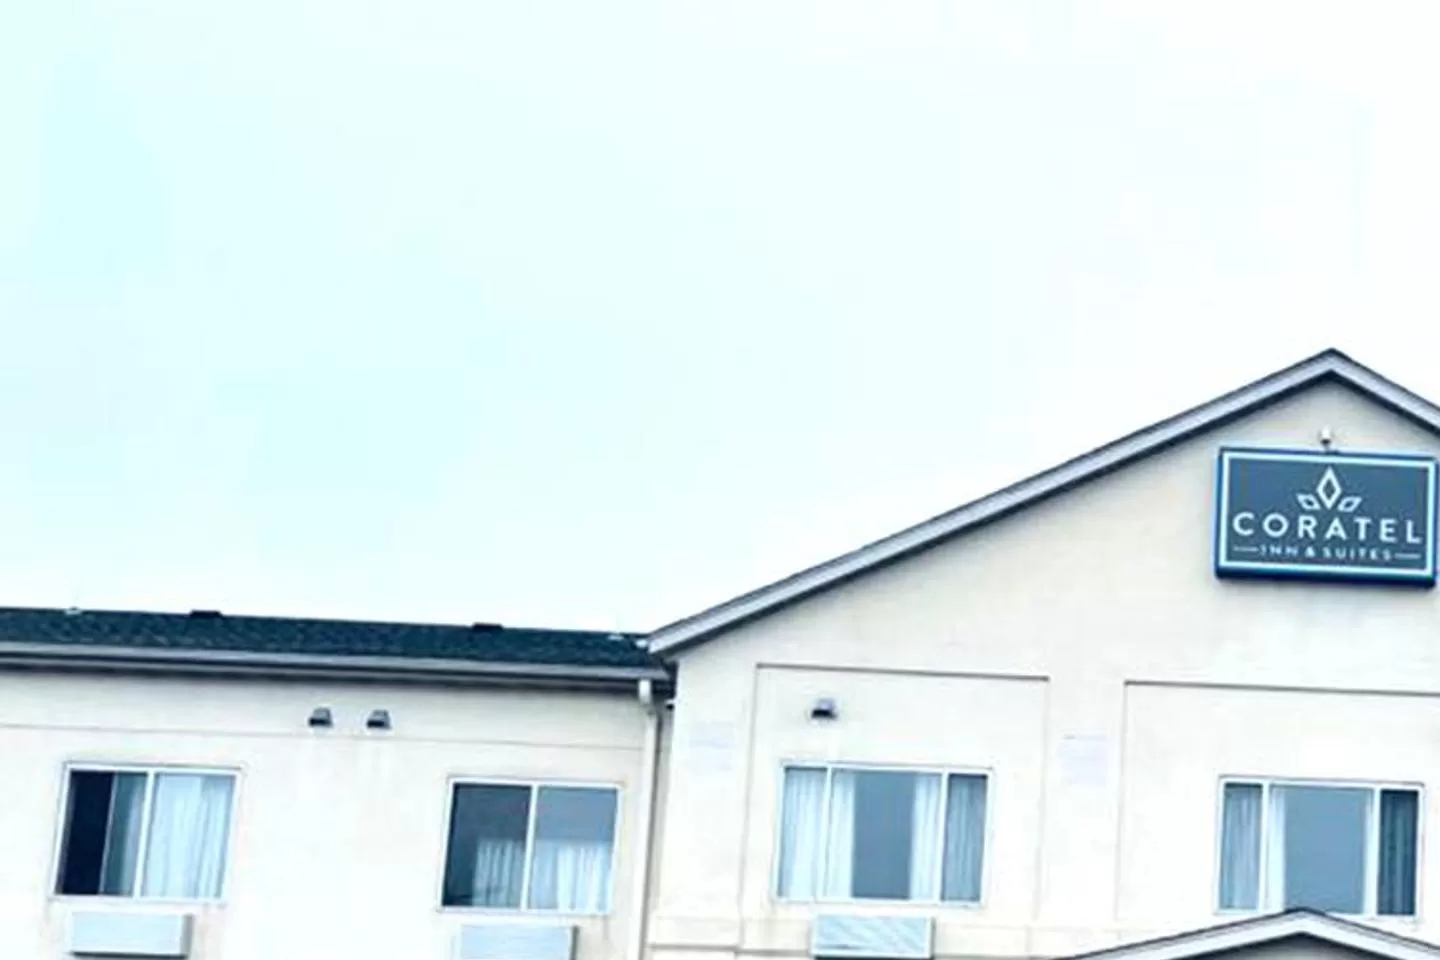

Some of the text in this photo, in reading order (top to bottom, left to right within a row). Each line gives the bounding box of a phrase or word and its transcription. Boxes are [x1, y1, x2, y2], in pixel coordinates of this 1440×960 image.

[1232, 512, 1421, 543] CORATEL
[1259, 543, 1392, 561] INN & SUITES
